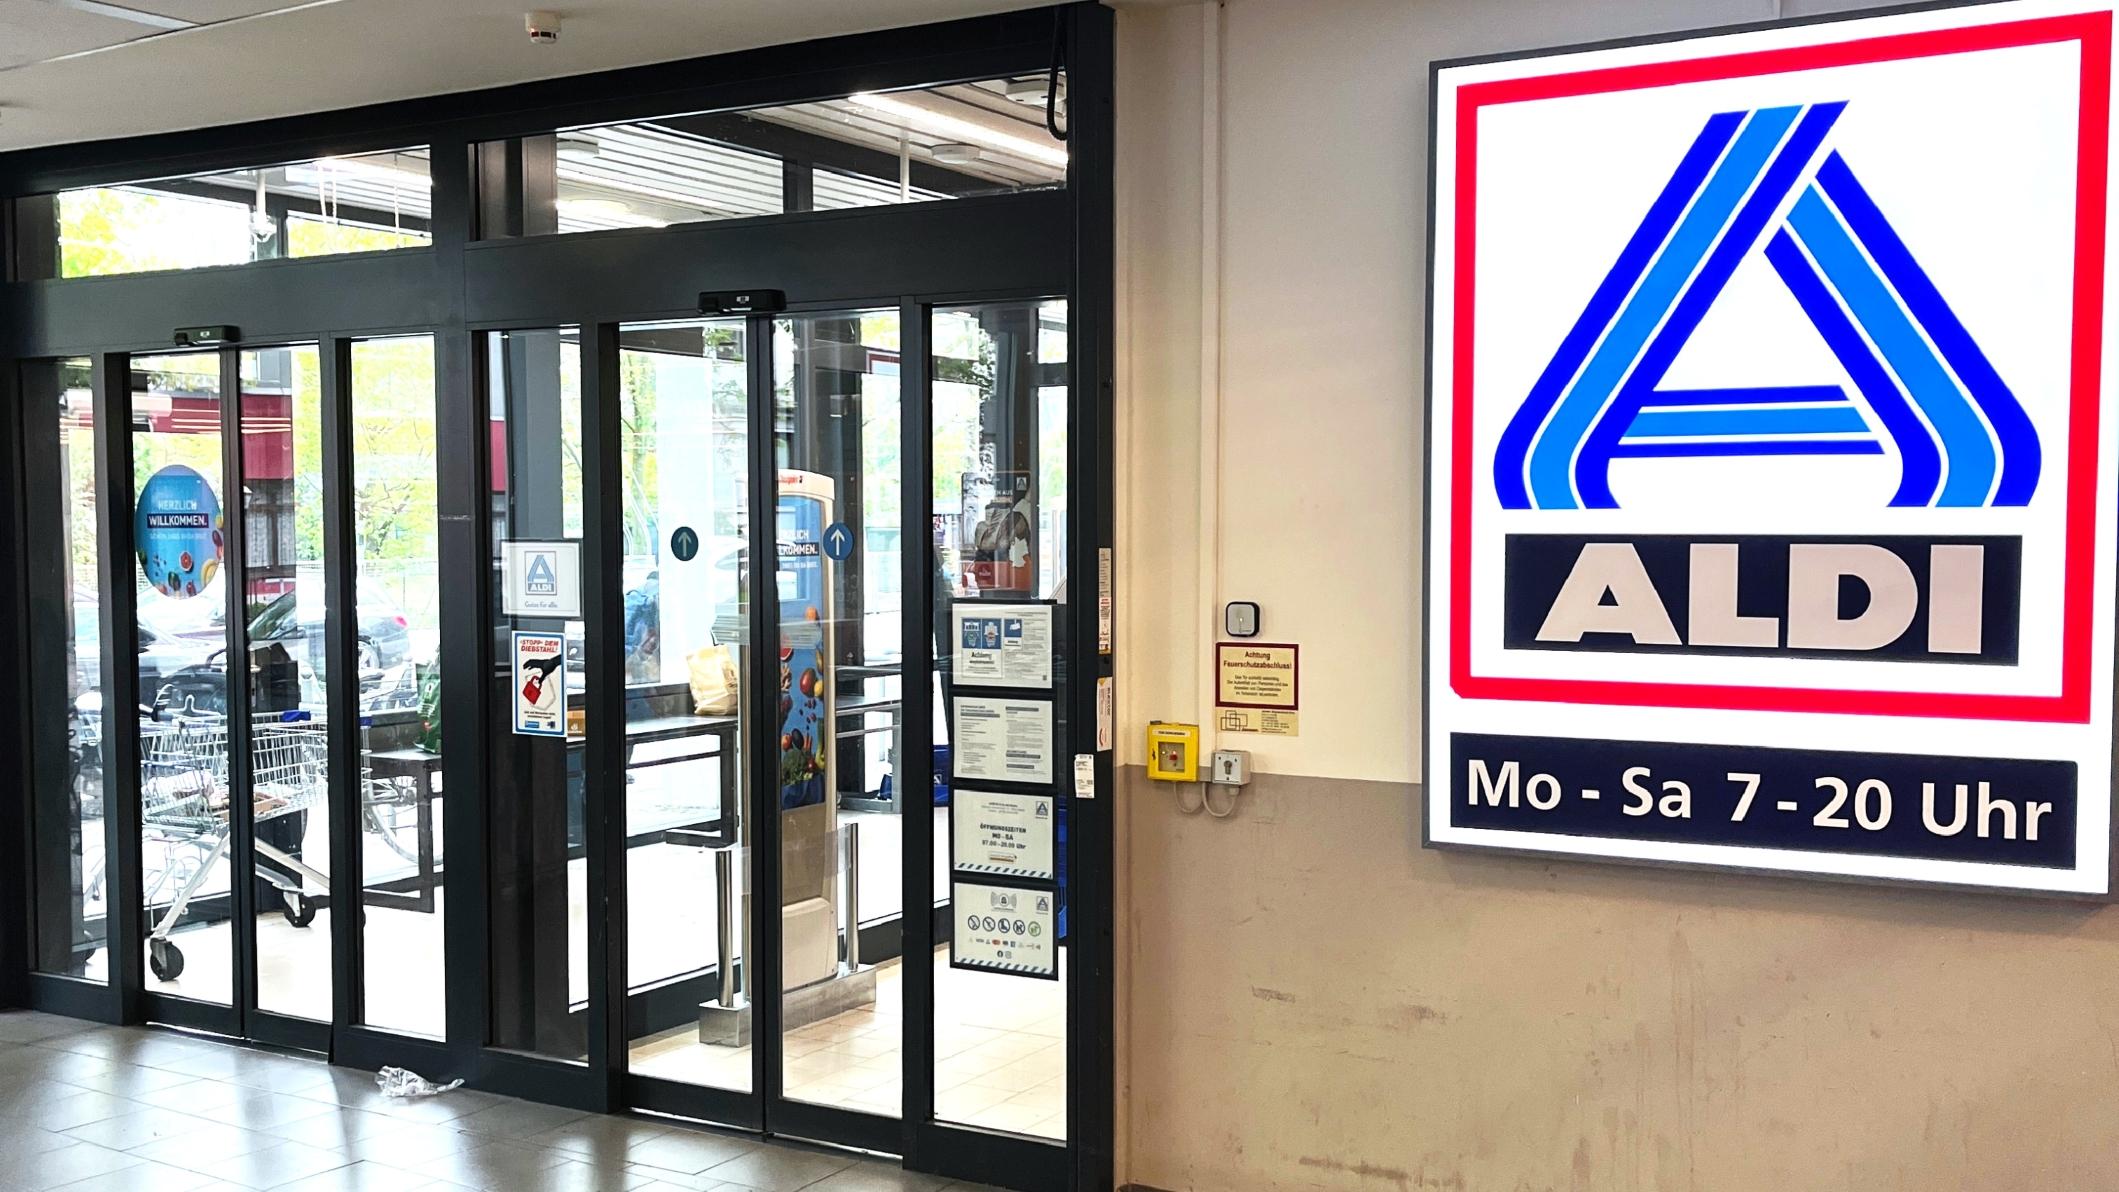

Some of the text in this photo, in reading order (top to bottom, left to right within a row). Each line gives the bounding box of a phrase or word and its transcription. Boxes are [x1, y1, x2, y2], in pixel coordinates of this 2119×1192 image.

[158, 500, 198, 511] HERZLICH
[148, 514, 208, 526] WILLKOMMEN.
[529, 583, 552, 592] ALDI
[1534, 542, 1985, 654] ALDI
[1244, 651, 1271, 661] Achtung
[1223, 660, 1292, 670] Feuerschutzabschluss!
[1465, 759, 2053, 842] Mo - Sa 7 - 20 Uhr
